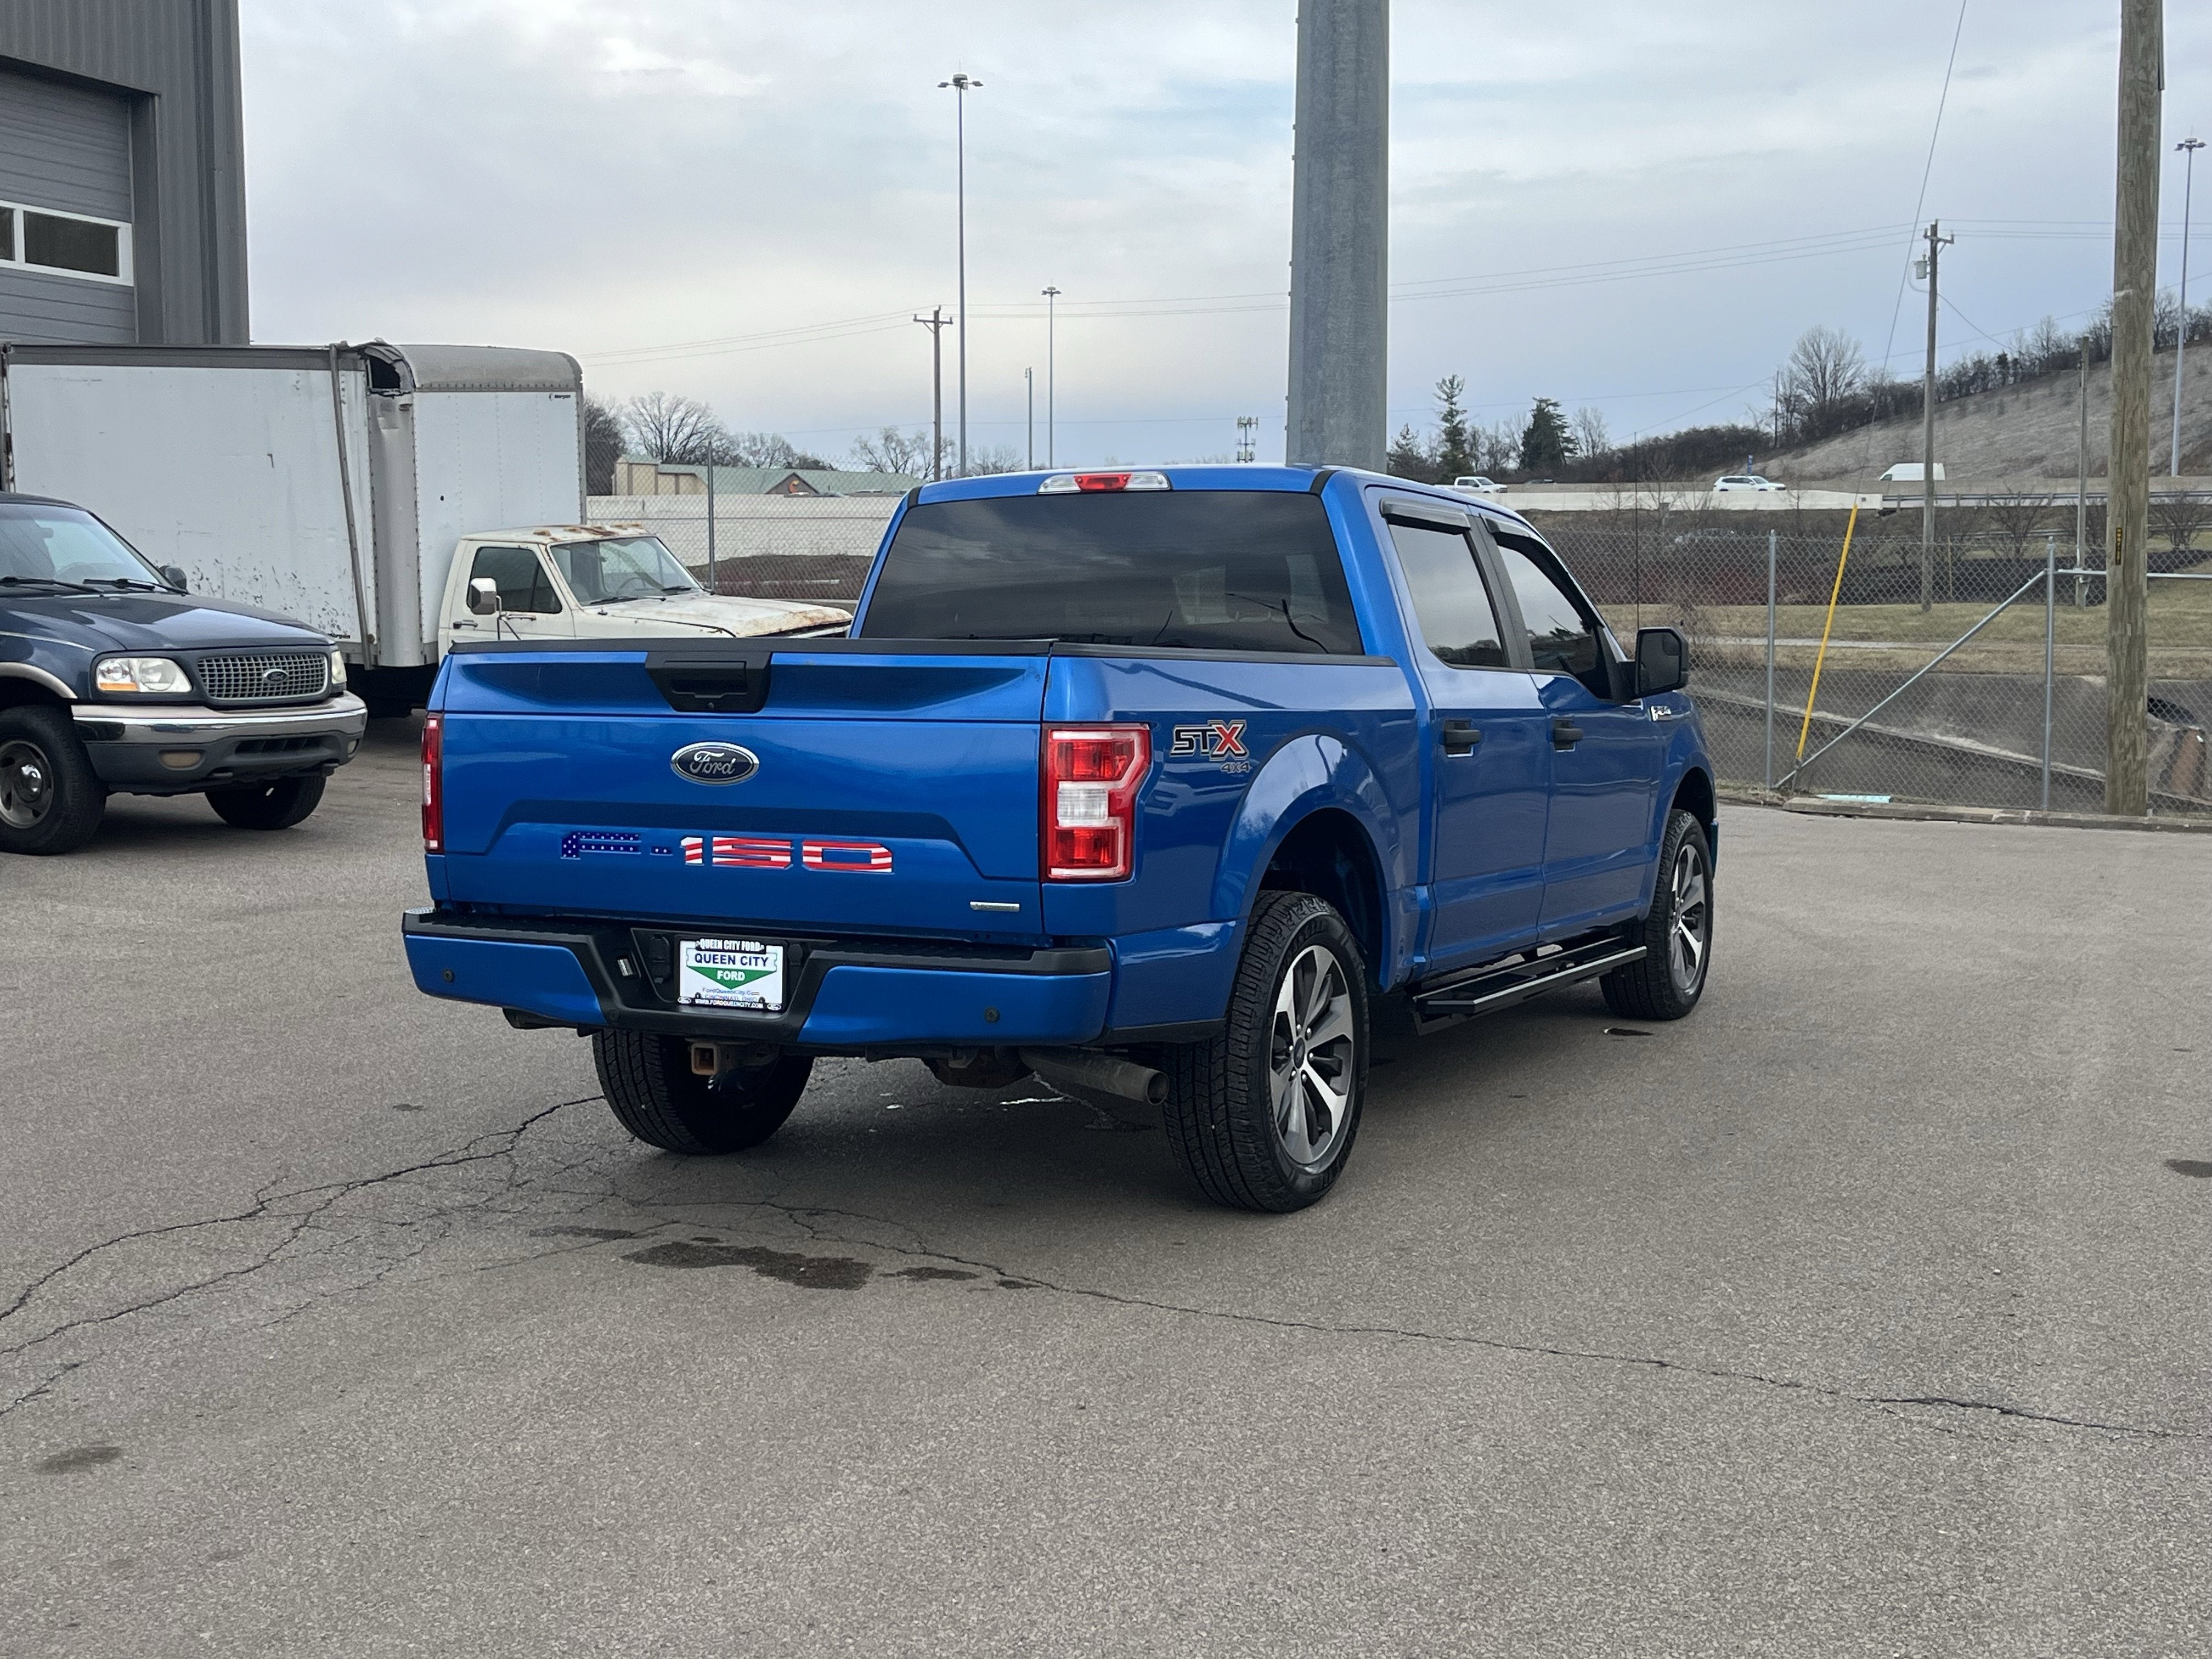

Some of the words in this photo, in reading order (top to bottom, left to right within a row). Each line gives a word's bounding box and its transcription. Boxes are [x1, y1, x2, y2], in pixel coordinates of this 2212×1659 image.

[1170, 719, 1250, 761] STX
[690, 751, 736, 775] Ford
[561, 831, 894, 874] F-150
[699, 938, 723, 950] QUEEN
[724, 940, 741, 951] CITY
[741, 941, 760, 951] FORD
[695, 953, 736, 965] QUEEN
[740, 956, 769, 967] CITY
[716, 970, 746, 981] FORD
